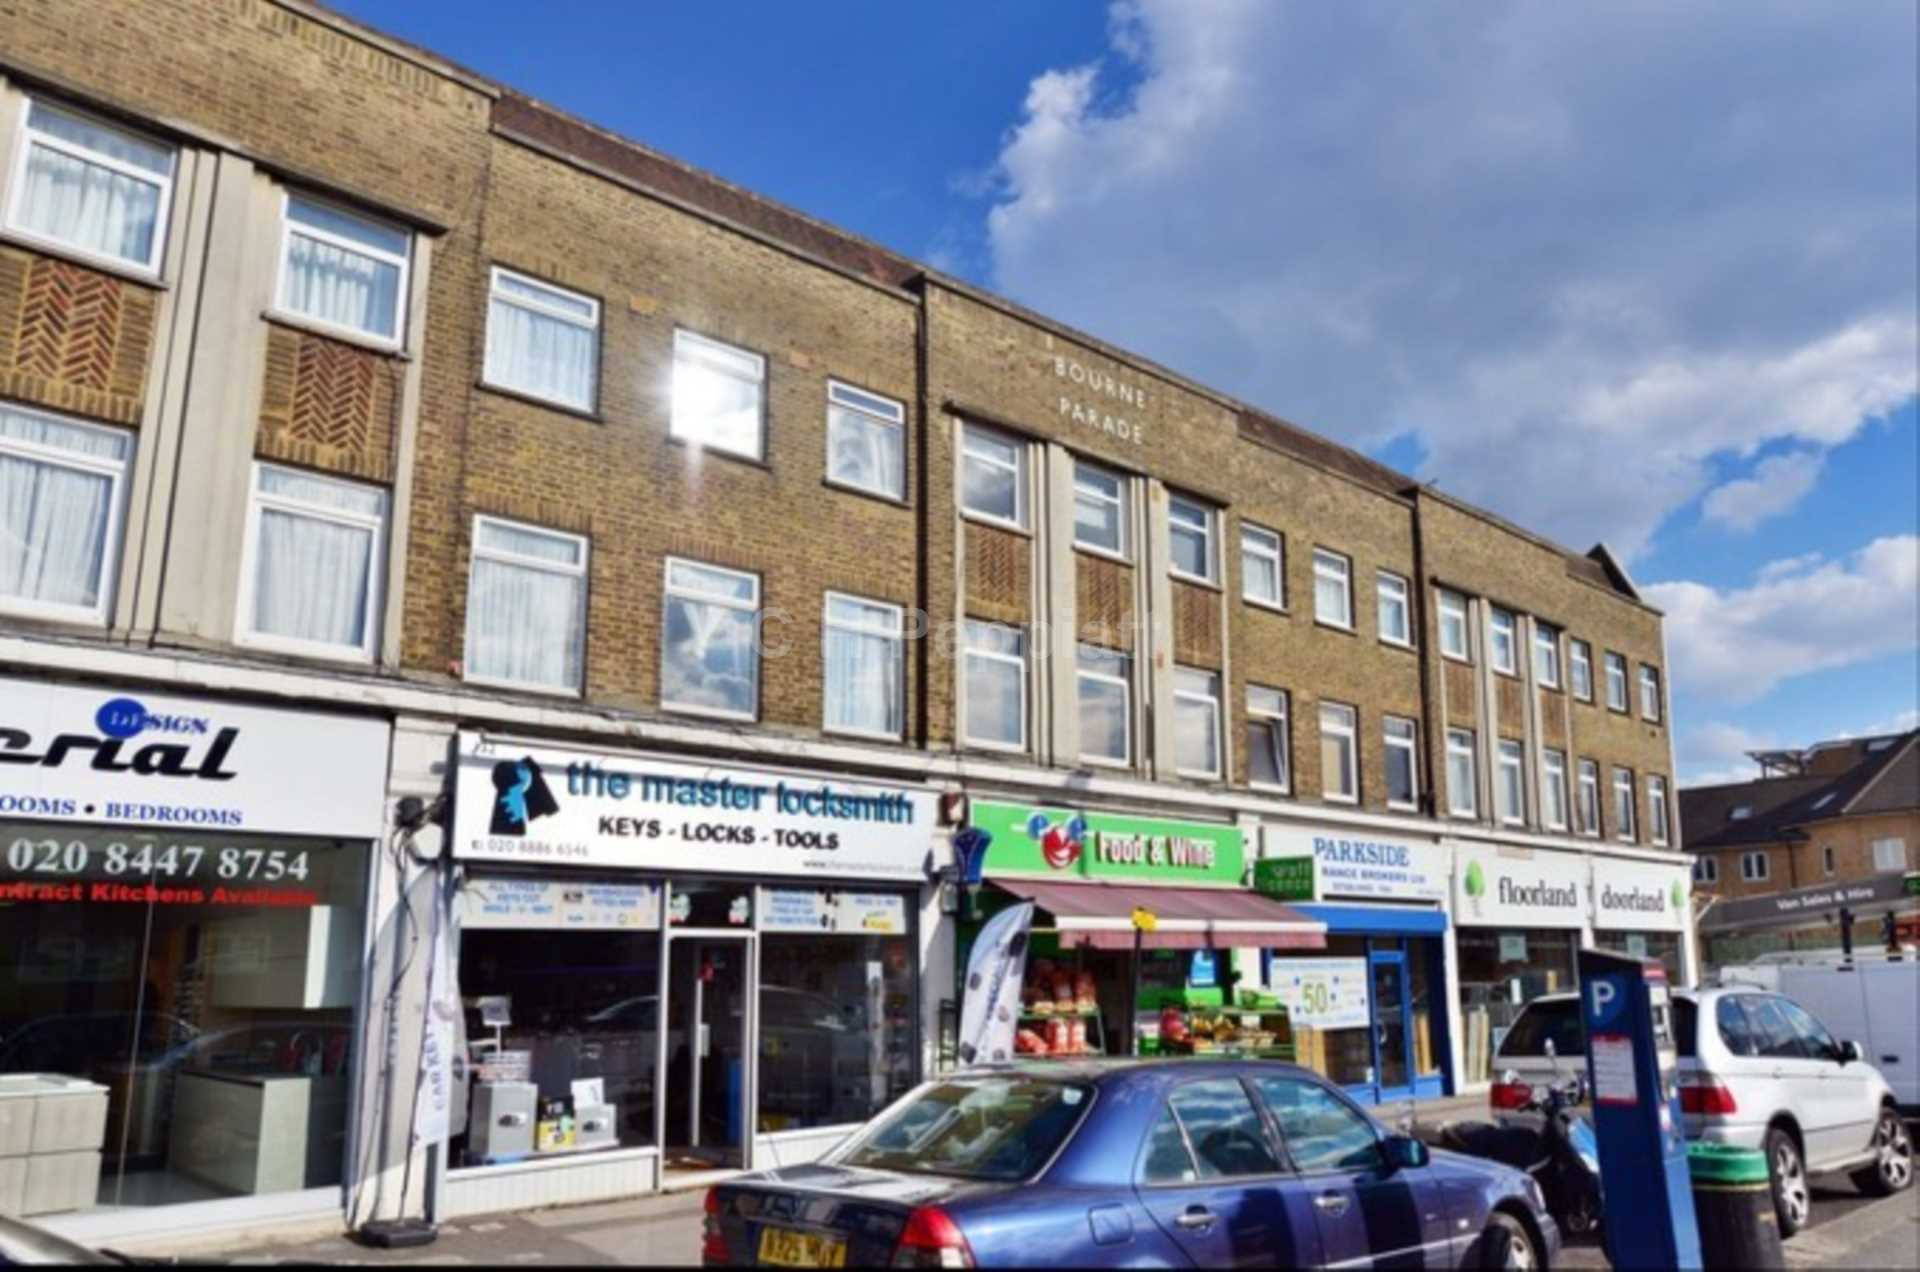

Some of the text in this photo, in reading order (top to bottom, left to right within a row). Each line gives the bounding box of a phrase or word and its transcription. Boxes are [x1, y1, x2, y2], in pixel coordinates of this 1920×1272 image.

[1055, 356, 1145, 408] BOURNE
[1060, 397, 1142, 445] PARADE
[567, 761, 914, 824] the master locksmith
[105, 801, 244, 826] BEDROOMS
[598, 815, 840, 850] KEYS LOCKS TOOLS
[1096, 831, 1144, 864] Food
[7, 837, 309, 881] 020 8447 8754
[1312, 837, 1411, 867] PARKSIDE
[91, 881, 202, 903] Kitchens
[1498, 876, 1666, 912] floorland doorland
[1590, 980, 1616, 1017] P
